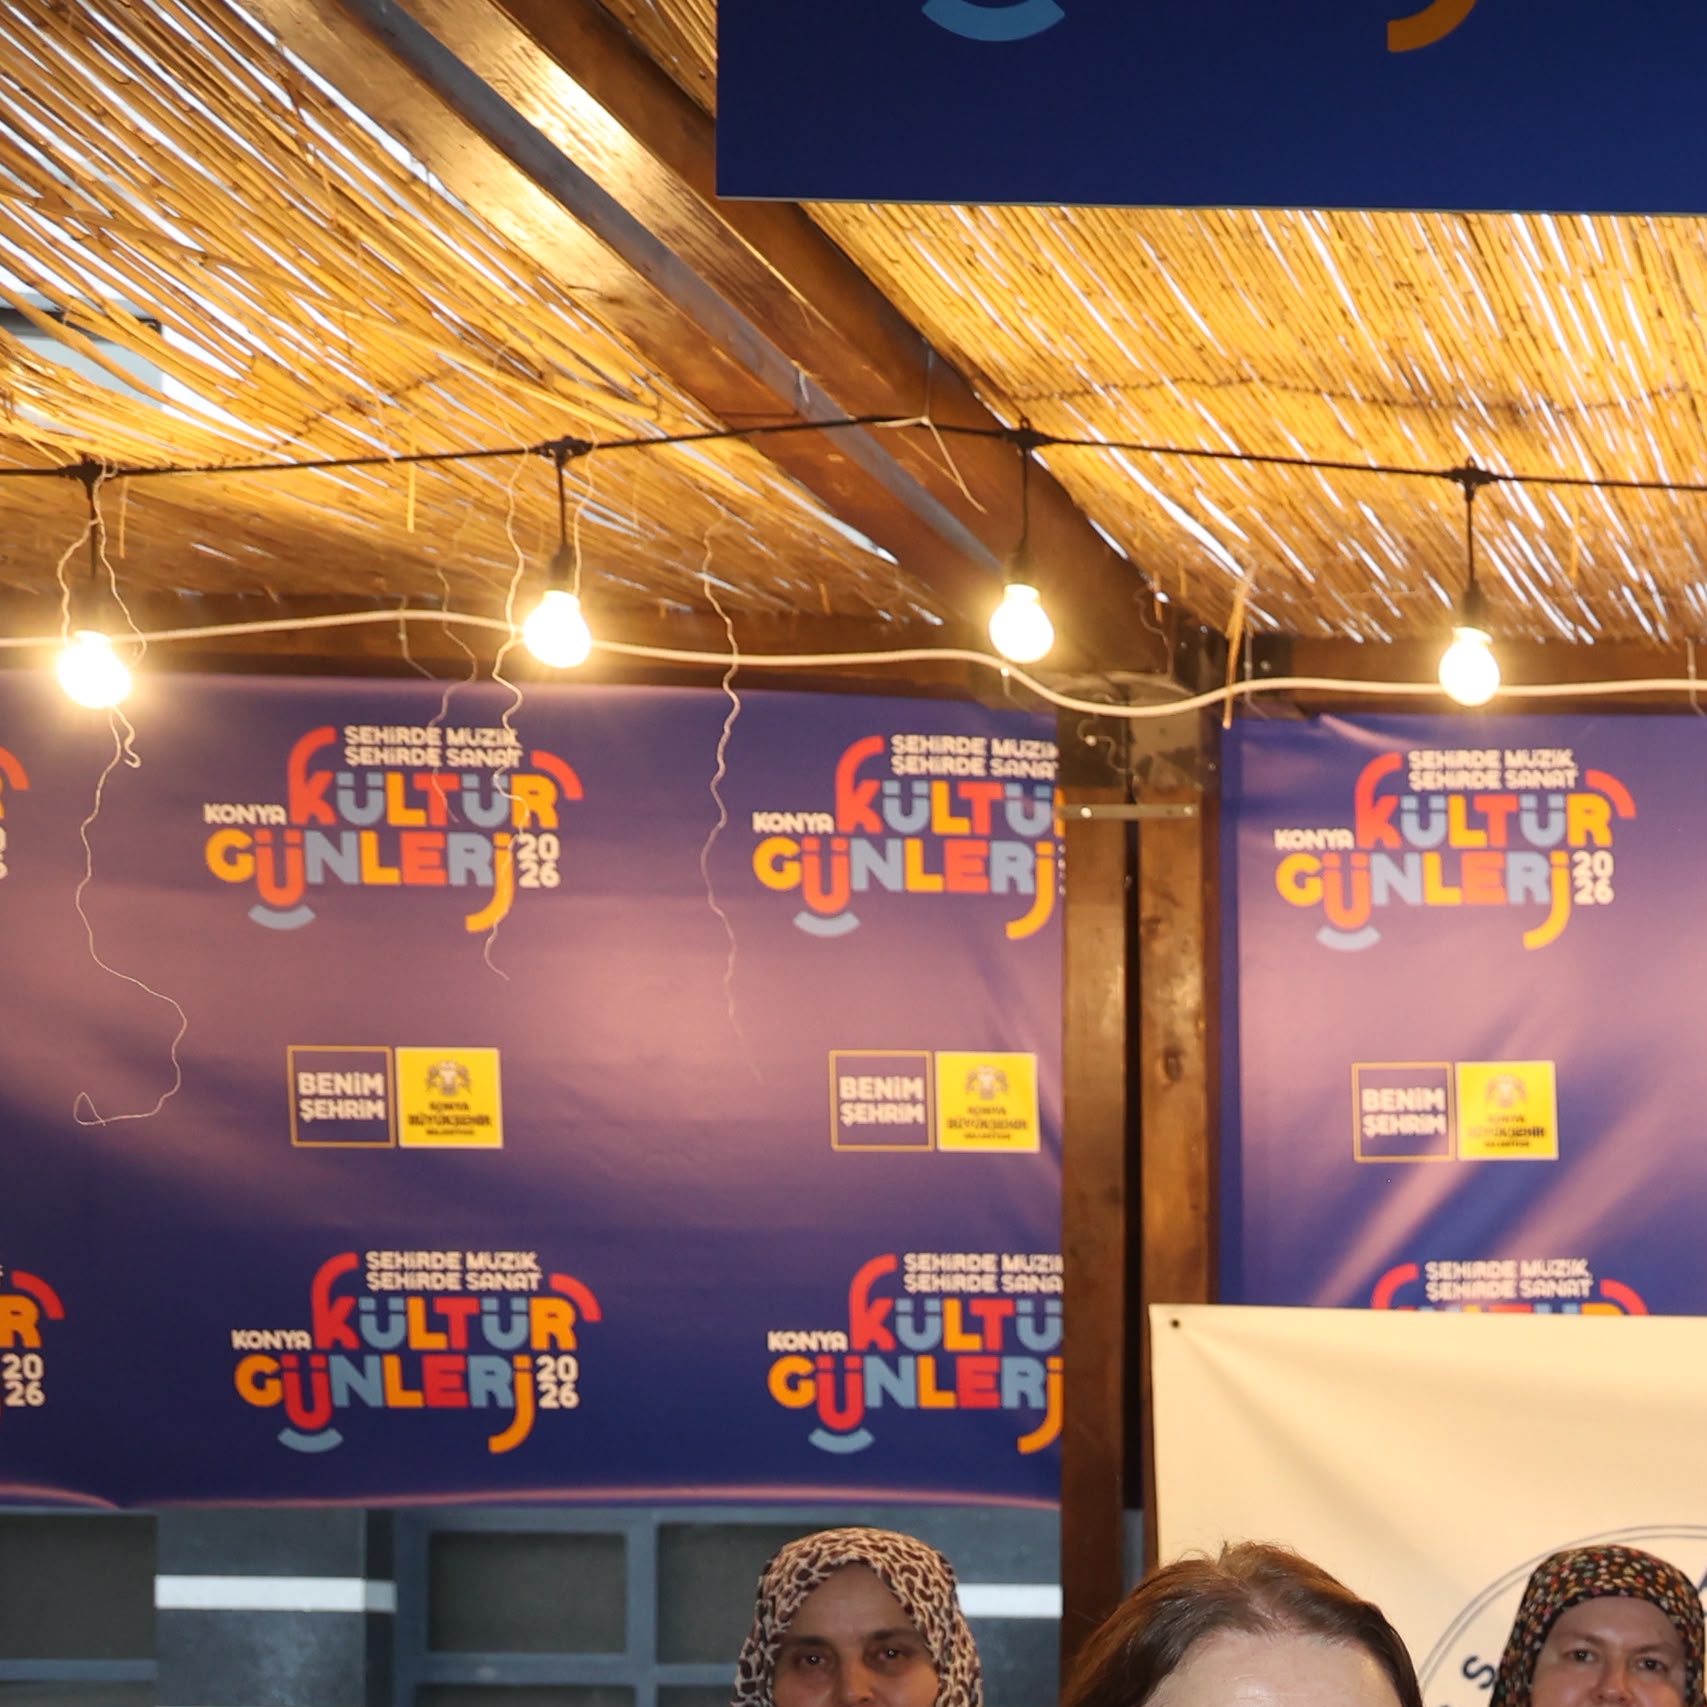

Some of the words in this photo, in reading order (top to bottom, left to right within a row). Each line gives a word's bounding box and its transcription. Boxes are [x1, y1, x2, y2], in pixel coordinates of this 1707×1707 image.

[204, 803, 287, 825] KONYA
[287, 726, 559, 828] KÜLTÜR
[990, 758, 1058, 779] SANA
[752, 812, 834, 833] KONYA
[835, 735, 1066, 837] KÜLTÜ
[1274, 829, 1354, 850] KONYA
[1355, 752, 1613, 849] KÜLTÜR
[517, 833, 560, 860] 20
[518, 860, 560, 888] 26
[1572, 851, 1614, 877] 20
[1574, 877, 1615, 905] 26
[297, 1072, 384, 1096] BENİM
[1002, 1274, 1063, 1293] SANA
[231, 1329, 312, 1350] KONYA
[311, 1252, 577, 1350] KÜLTÜR
[767, 1330, 848, 1352] KONYA
[849, 1254, 1063, 1351] KÜLTÜ
[1, 1353, 44, 1381] 20
[536, 1355, 578, 1382] 20
[5, 1381, 45, 1407] 26
[539, 1382, 579, 1408] 26
